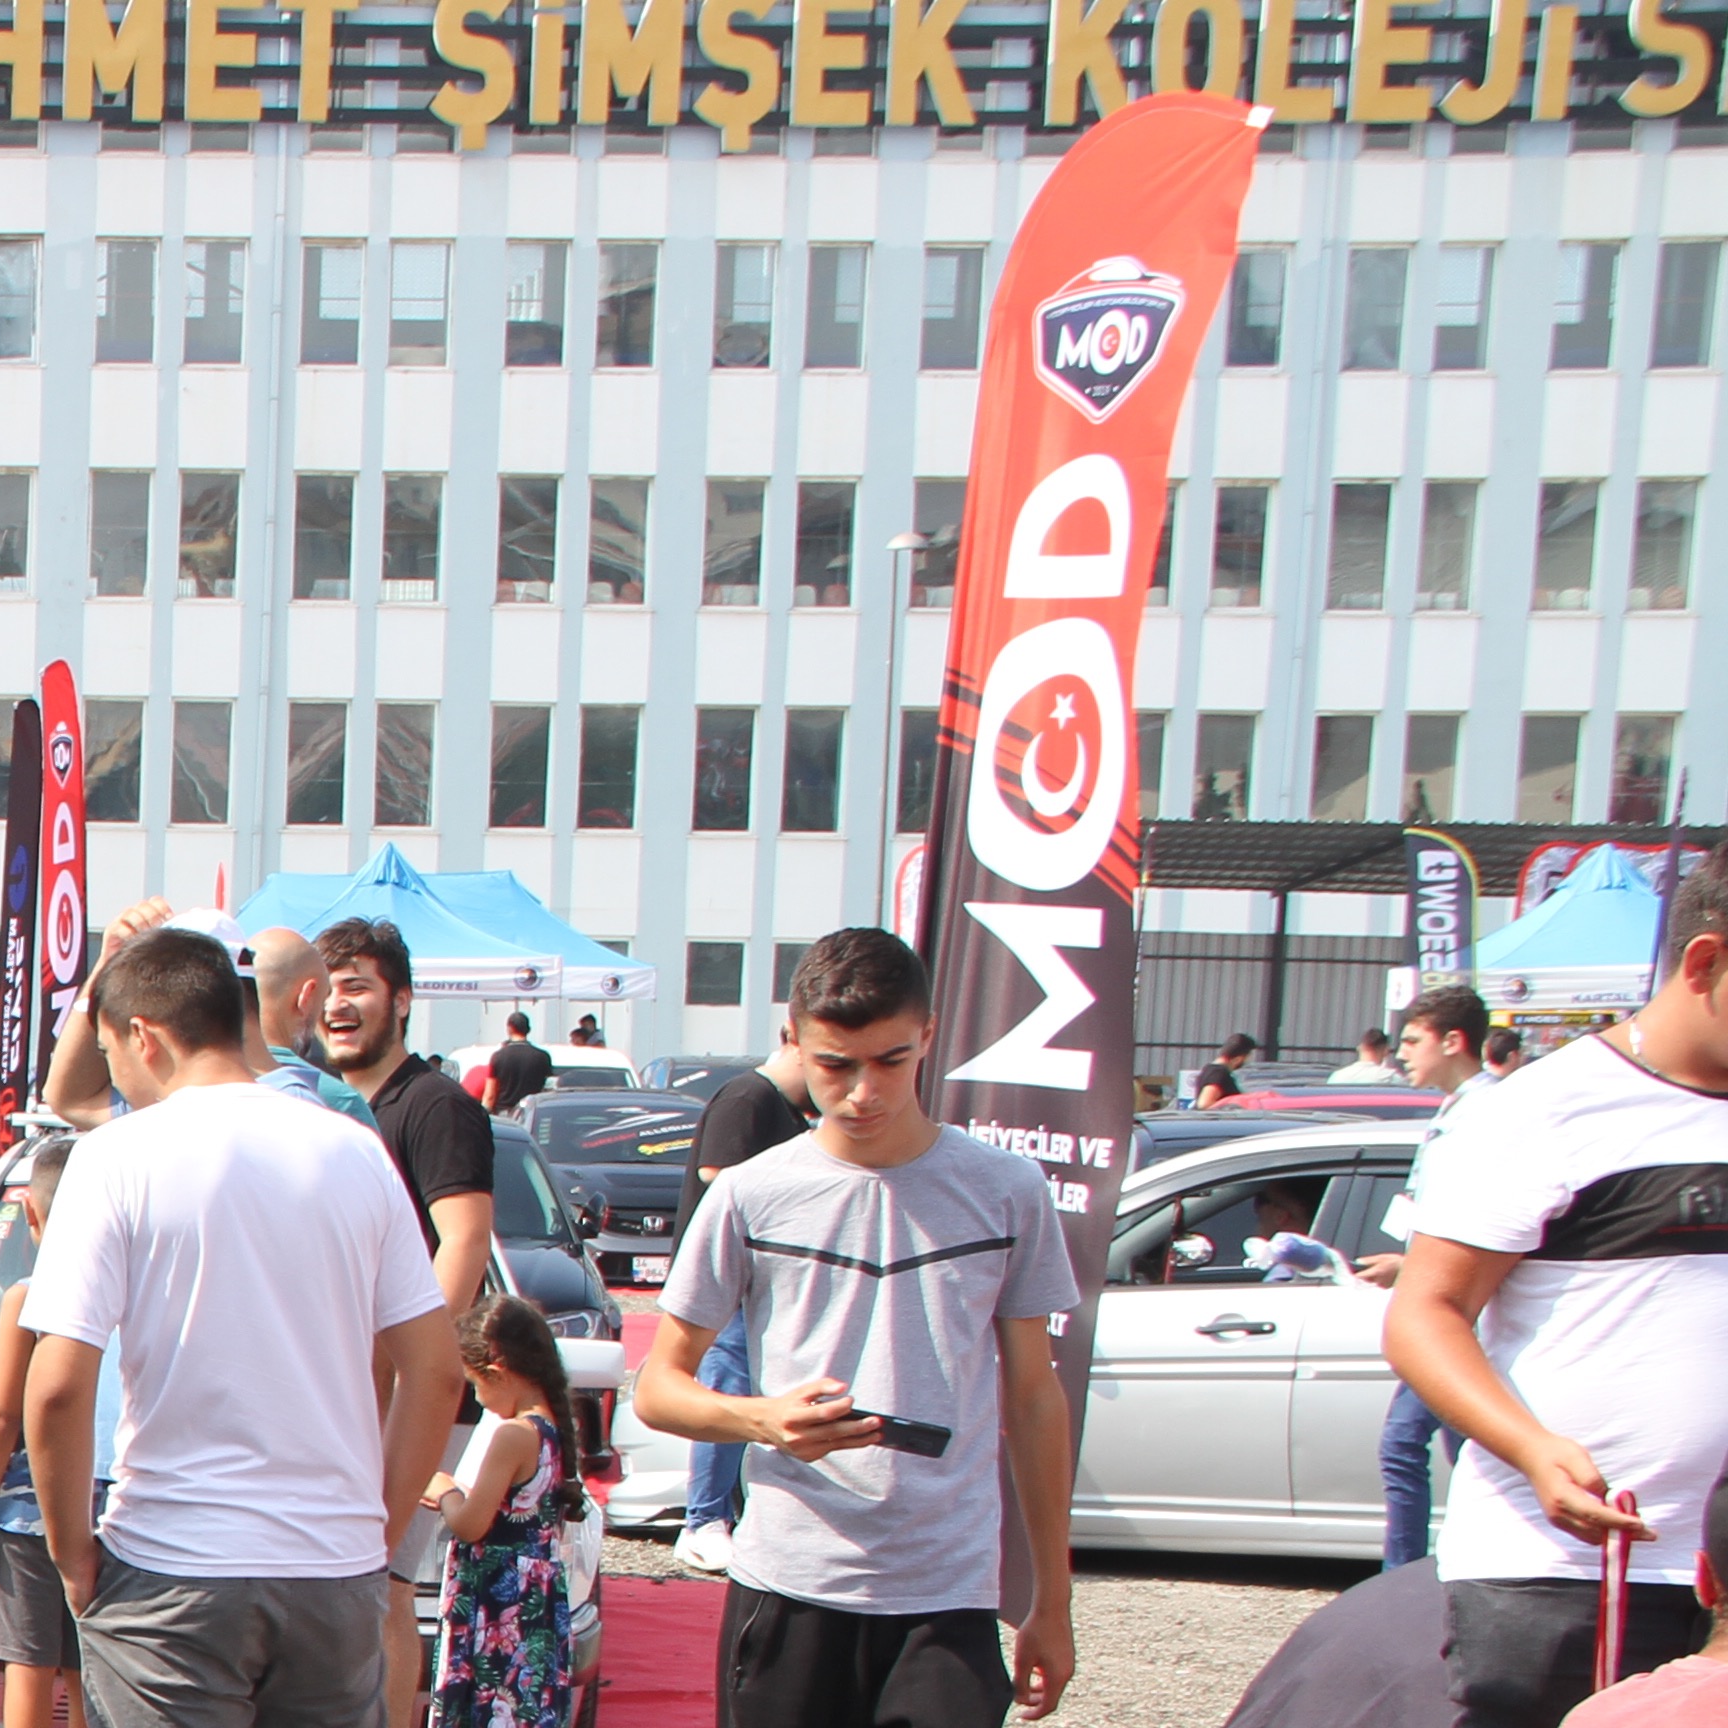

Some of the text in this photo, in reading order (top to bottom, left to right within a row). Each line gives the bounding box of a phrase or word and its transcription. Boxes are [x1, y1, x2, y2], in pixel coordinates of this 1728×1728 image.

[428, 0, 977, 152] ŞİMŞEK
[1618, 0, 1728, 119] S
[1055, 309, 1150, 375] MOD
[944, 452, 1132, 1091] MOD
[1079, 1136, 1116, 1168] VE
